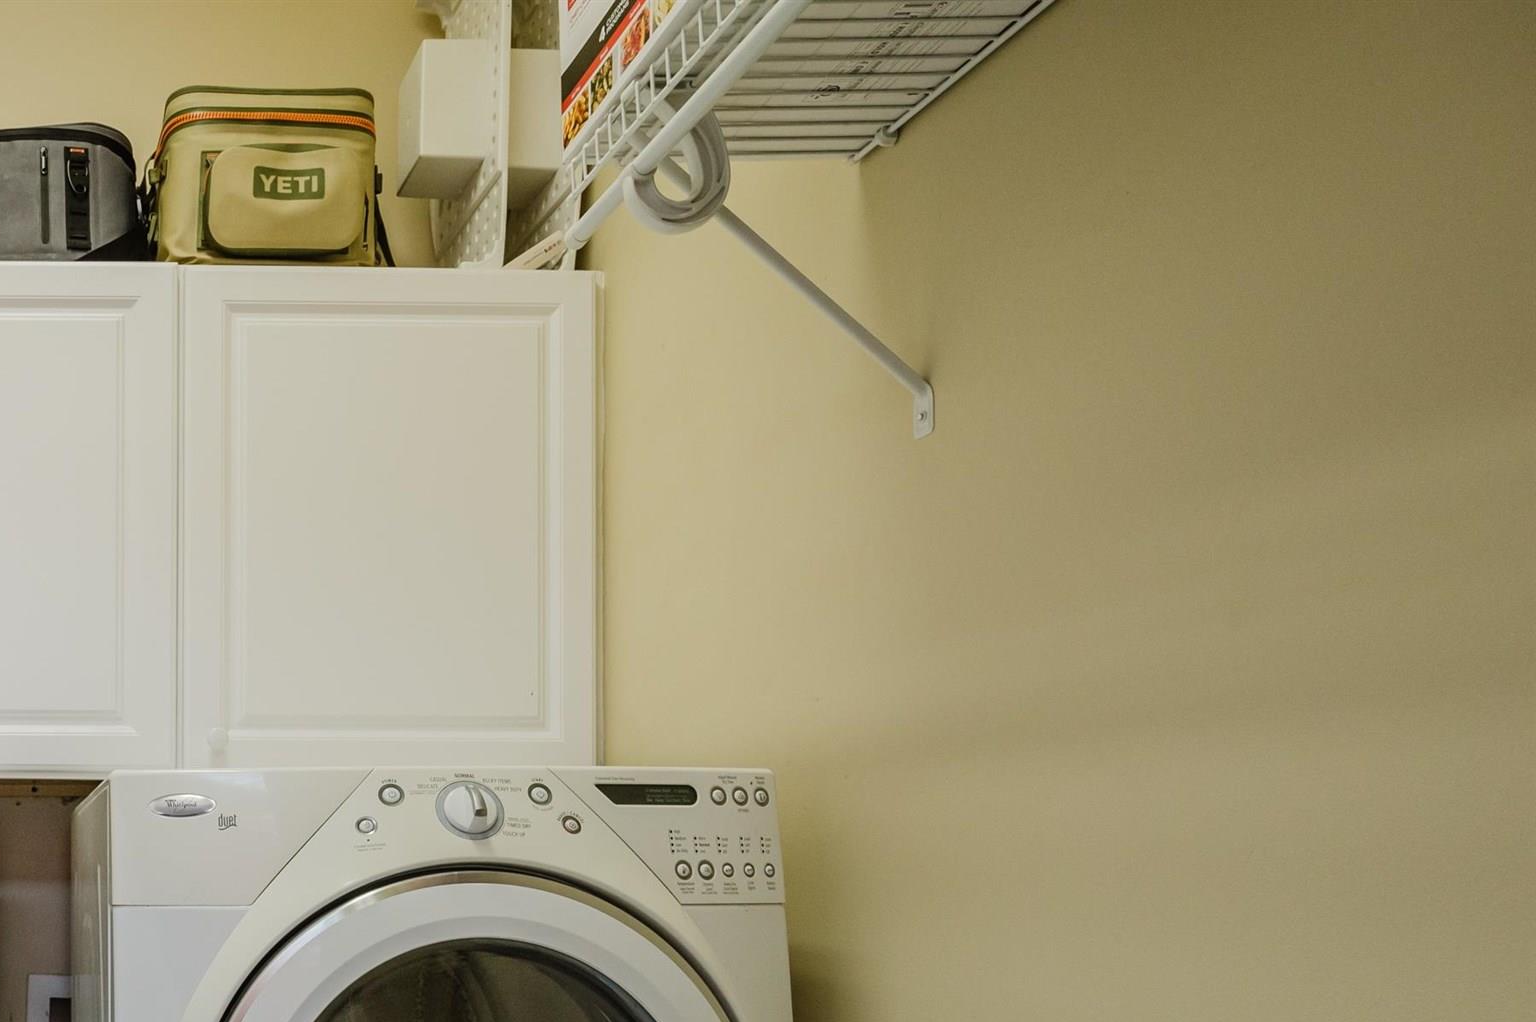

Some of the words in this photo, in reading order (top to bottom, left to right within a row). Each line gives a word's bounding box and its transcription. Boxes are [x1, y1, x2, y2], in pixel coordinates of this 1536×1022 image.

[259, 173, 319, 194] YETI
[165, 799, 197, 809] Whirlpool
[218, 813, 237, 830] duet
